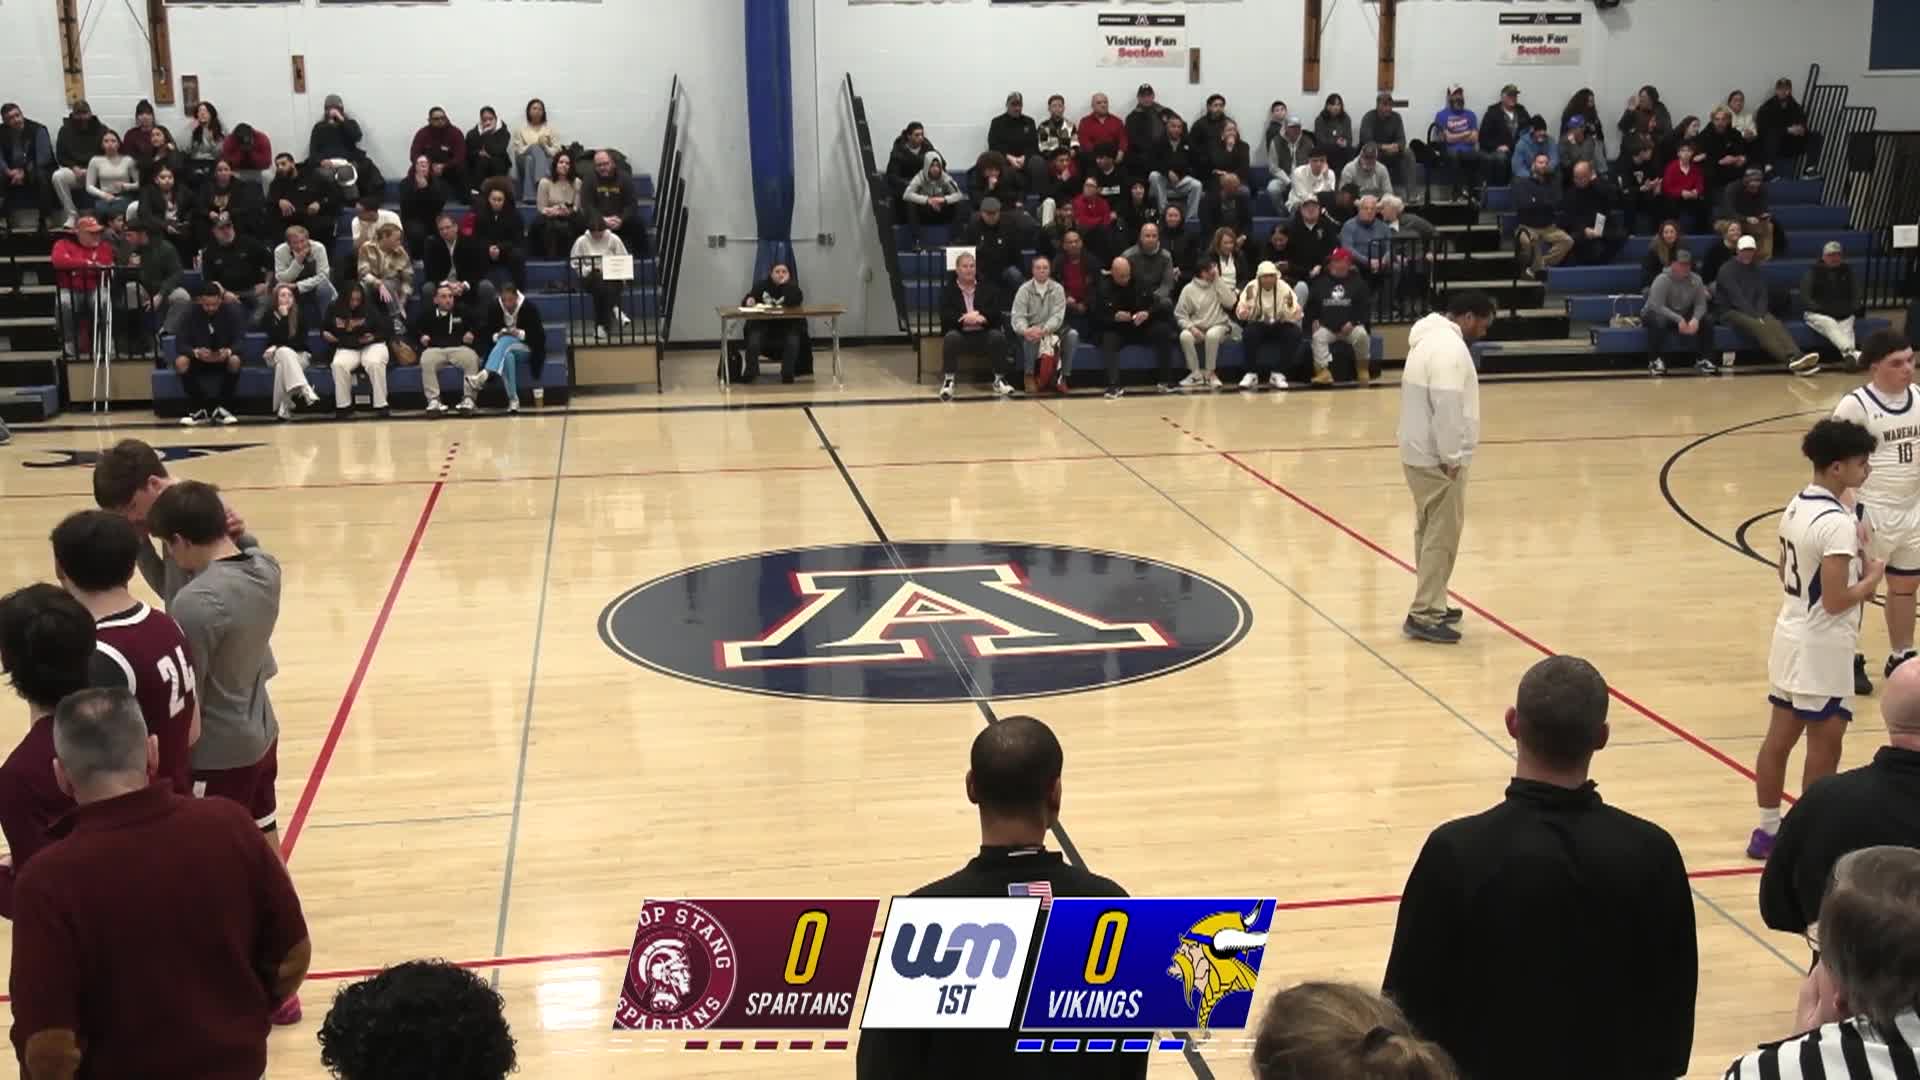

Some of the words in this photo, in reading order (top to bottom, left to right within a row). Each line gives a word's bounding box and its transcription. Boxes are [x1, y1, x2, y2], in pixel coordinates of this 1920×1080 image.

[1106, 35, 1151, 48] Visiting
[1155, 36, 1177, 46] Fan
[1511, 33, 1544, 44] Home
[1547, 33, 1568, 44] Fan
[1118, 47, 1164, 57] Section
[1518, 45, 1561, 56] Section
[1898, 442, 1913, 464] 10
[715, 562, 1178, 670] A
[157, 645, 199, 718] 24
